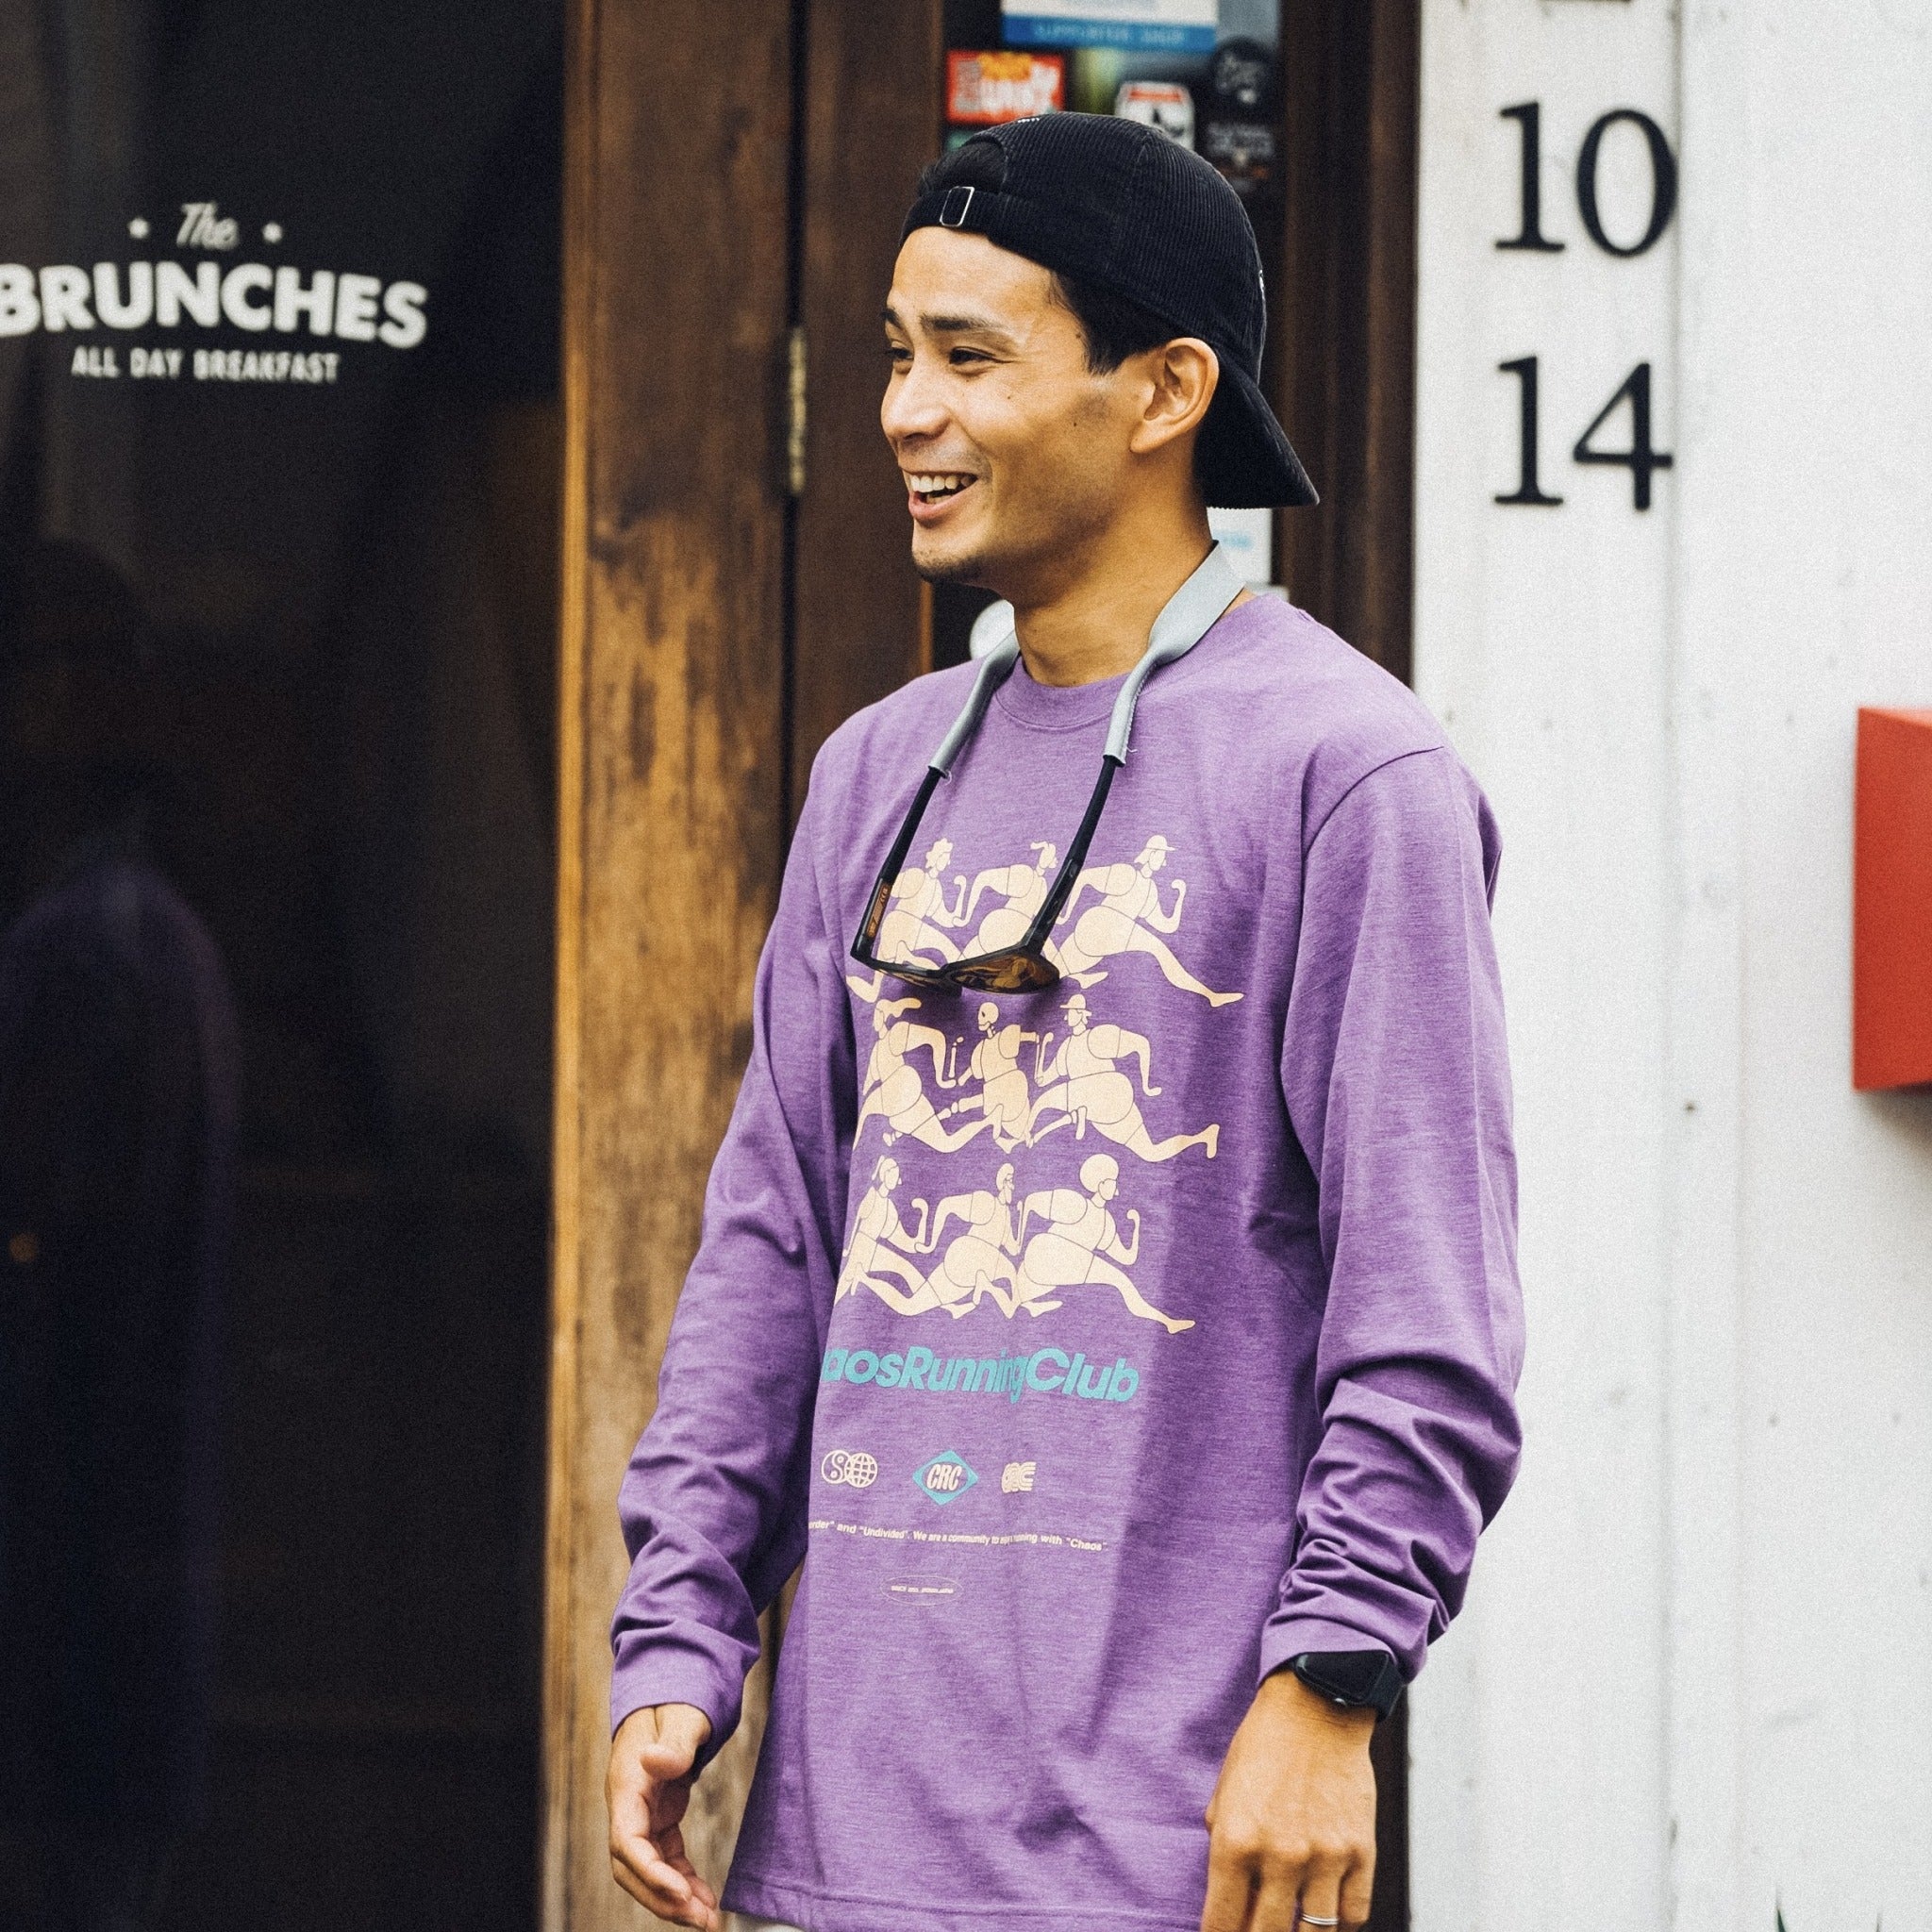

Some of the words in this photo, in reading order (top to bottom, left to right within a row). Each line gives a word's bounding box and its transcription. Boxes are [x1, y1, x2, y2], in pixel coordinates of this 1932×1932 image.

[1495, 101, 1679, 258] 10
[176, 201, 241, 250] The
[0, 260, 428, 349] BRUNCHES
[71, 345, 120, 377] ALL
[130, 347, 183, 378] DAY
[193, 349, 341, 383] BREAKFAST
[1494, 356, 1674, 512] 14
[926, 1463, 962, 1491] CRC
[837, 1523, 858, 1535] and
[913, 1530, 928, 1541] We
[928, 1532, 941, 1542] are
[948, 1533, 990, 1546] community
[1041, 1534, 1063, 1545] with
